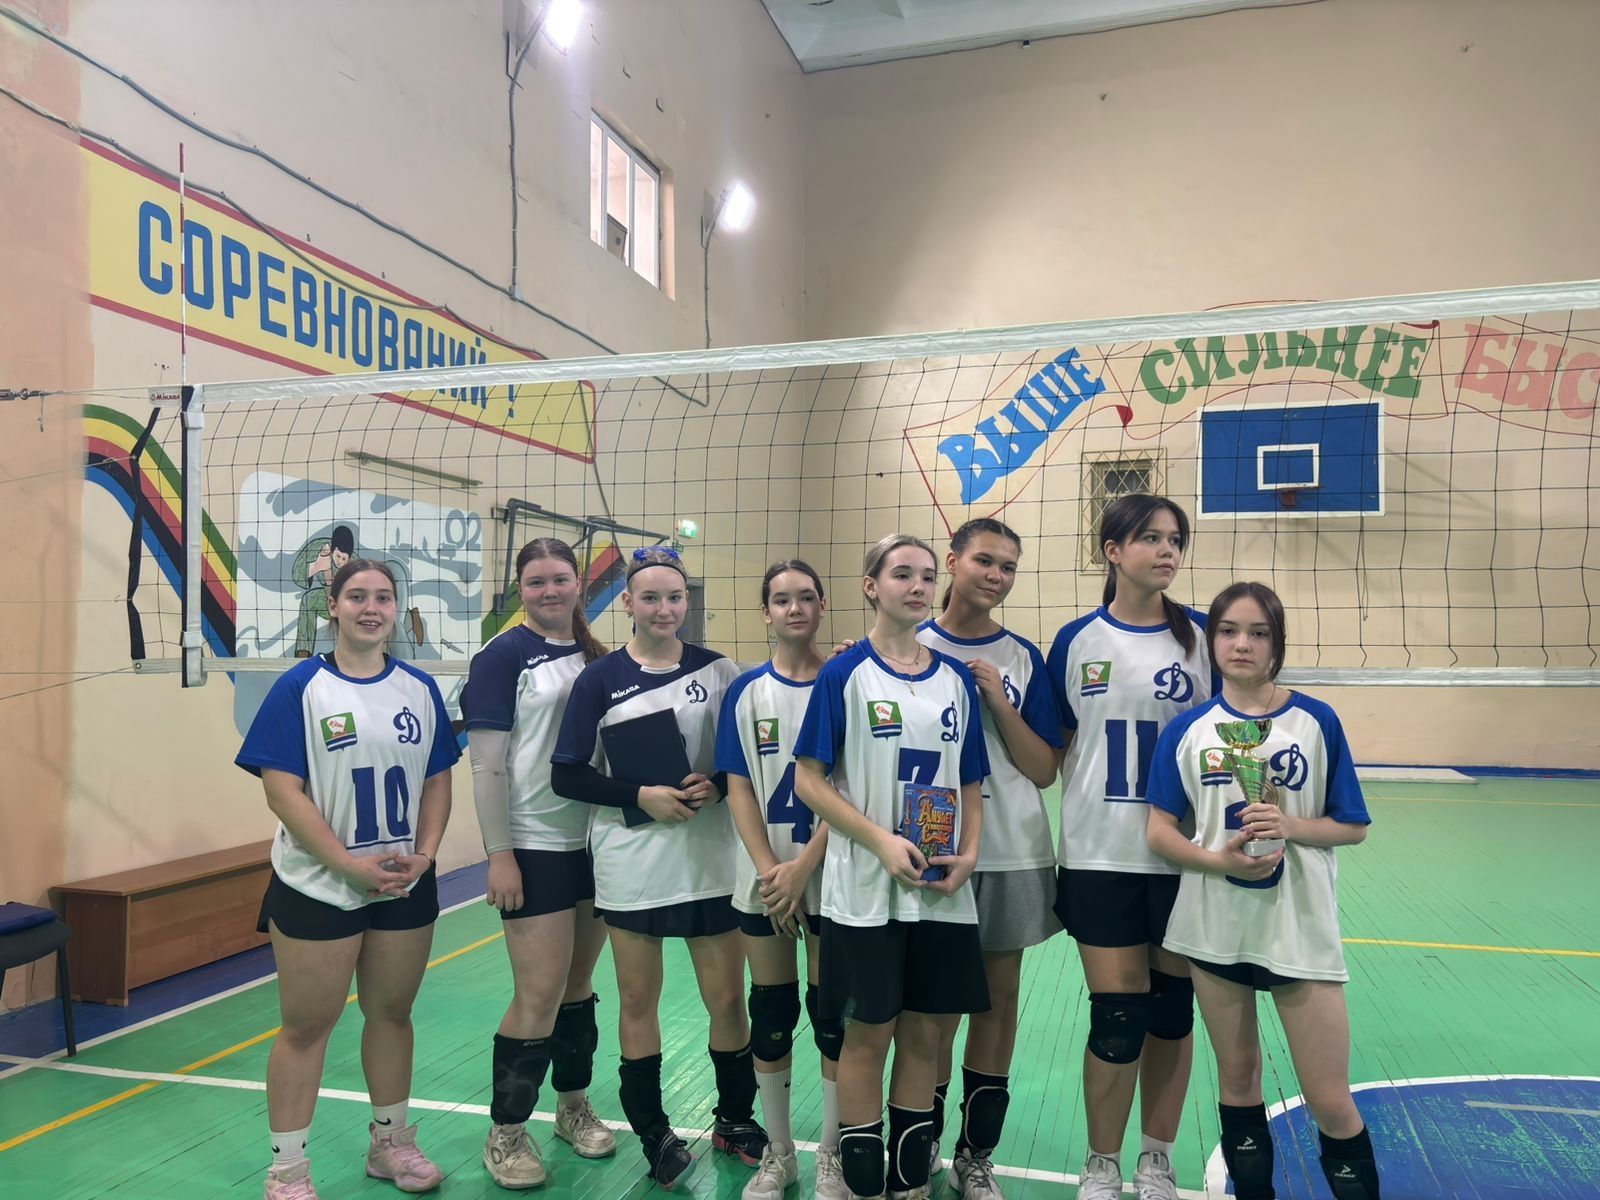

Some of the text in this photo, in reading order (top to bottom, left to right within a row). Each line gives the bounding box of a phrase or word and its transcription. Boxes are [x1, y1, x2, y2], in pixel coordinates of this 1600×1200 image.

[138, 199, 487, 410] СОРЕВНОВАНИЙ
[937, 346, 1107, 505] ВЫШЕ
[1139, 324, 1427, 405] СИЛЬНЕЕ
[1105, 719, 1158, 797] 11
[351, 765, 411, 844] 10
[767, 761, 814, 844] 4
